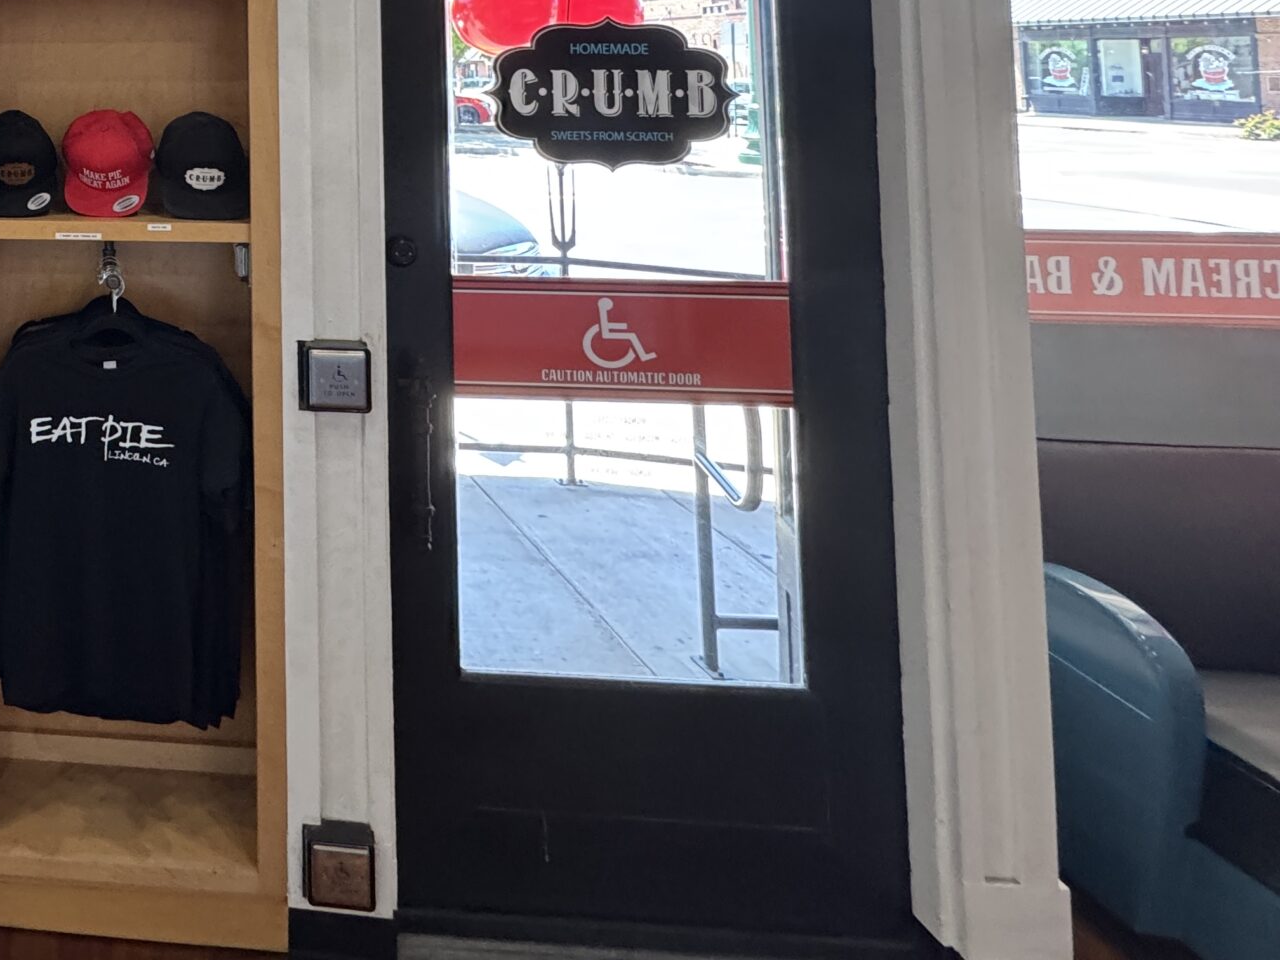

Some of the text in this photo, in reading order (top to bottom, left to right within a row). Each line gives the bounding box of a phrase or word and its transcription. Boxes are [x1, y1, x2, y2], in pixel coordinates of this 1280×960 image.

[570, 43, 649, 55] HOMEMADE
[551, 130, 674, 141] SWEETS FROM SCRATCH
[83, 167, 122, 181] MAKE PIE
[105, 175, 130, 190] AGAIN
[542, 369, 701, 385] CAUTION AUTOMATIC DOOR
[30, 414, 175, 461] EAT PIE
[153, 456, 169, 467] CA
